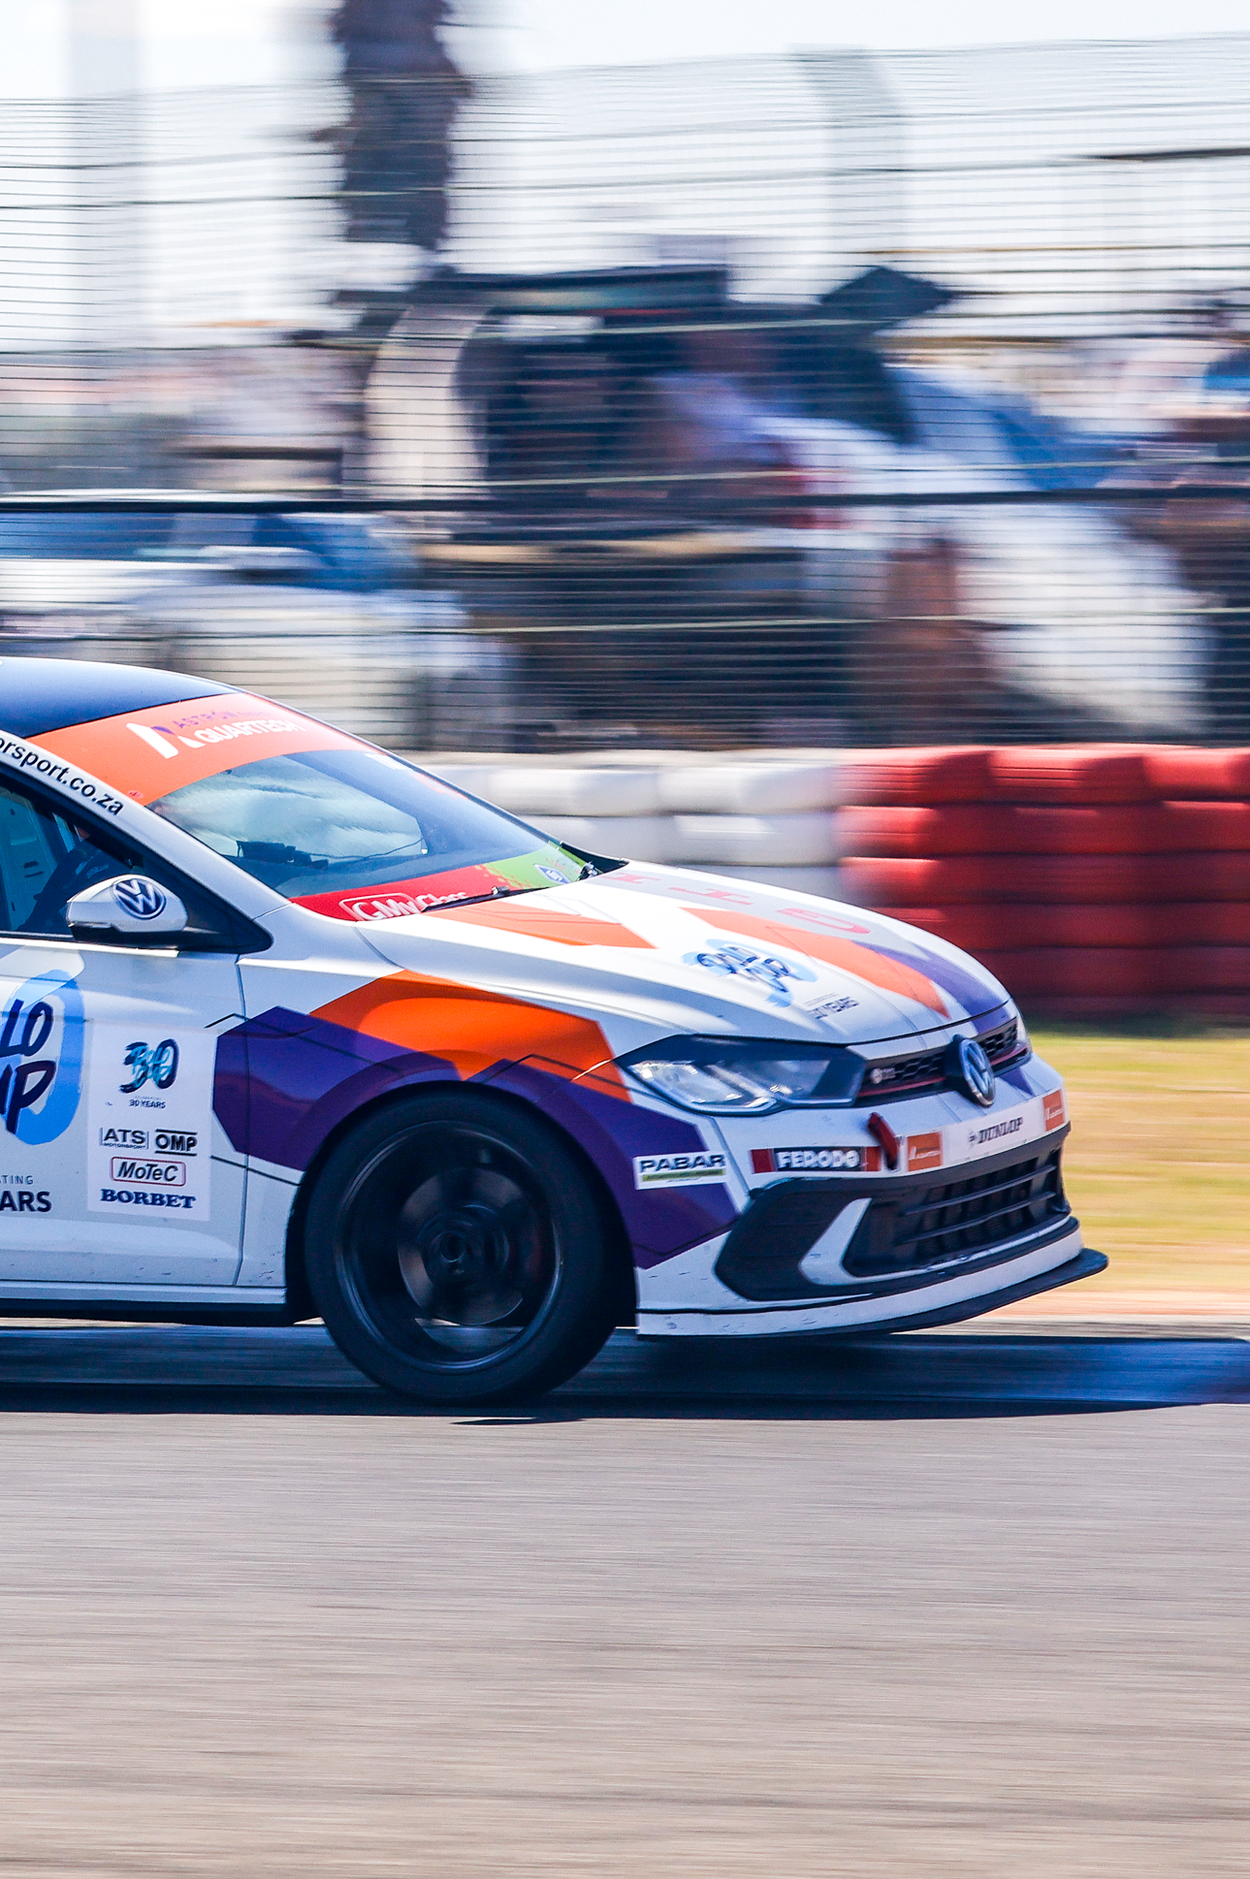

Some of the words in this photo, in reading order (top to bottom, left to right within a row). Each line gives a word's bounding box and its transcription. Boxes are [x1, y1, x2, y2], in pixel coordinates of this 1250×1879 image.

[141, 1100, 167, 1110] YEARS
[103, 1128, 146, 1144] ATS
[155, 1133, 198, 1151] OMP
[978, 1117, 1023, 1144] DUNLOP
[639, 1154, 725, 1173] PABAR
[777, 1149, 860, 1169] FERODO
[117, 1161, 179, 1182] MoTeC
[100, 1188, 197, 1209] BORBET
